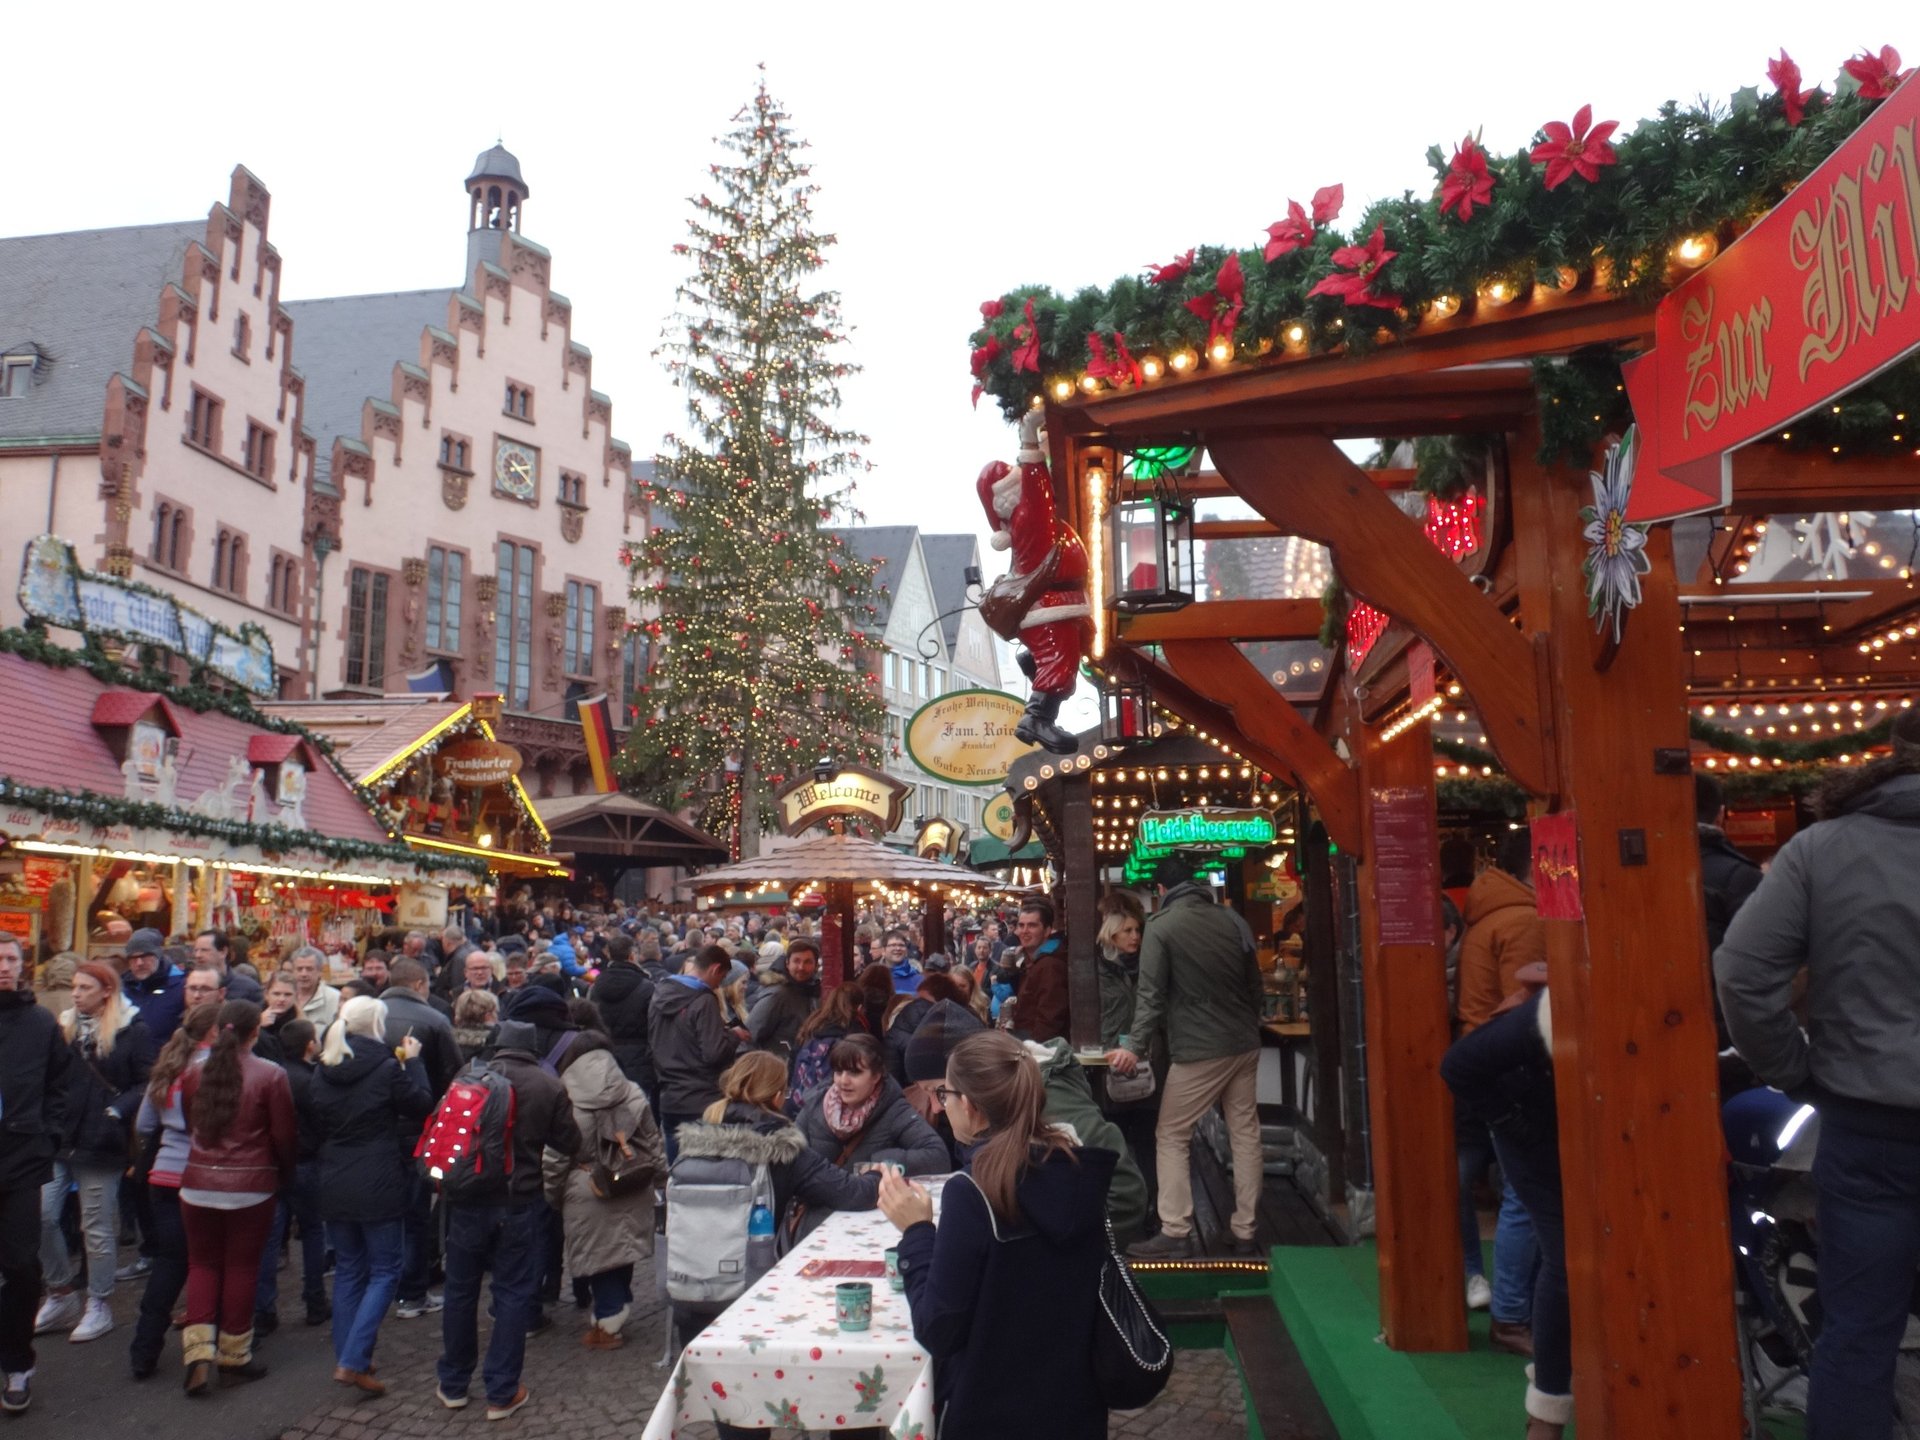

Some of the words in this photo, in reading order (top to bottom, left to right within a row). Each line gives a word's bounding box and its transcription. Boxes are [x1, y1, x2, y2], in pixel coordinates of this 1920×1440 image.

[1681, 285, 1773, 440] Zur
[934, 702, 962, 720] Frohe
[942, 722, 978, 739] Fam.
[960, 741, 996, 751] Frankfurt
[443, 757, 513, 770] Frankfurter
[933, 756, 963, 774] Gutes
[965, 763, 997, 777] Neues
[794, 783, 880, 815] Welcome
[1143, 815, 1272, 843] Heidelbeerwein
